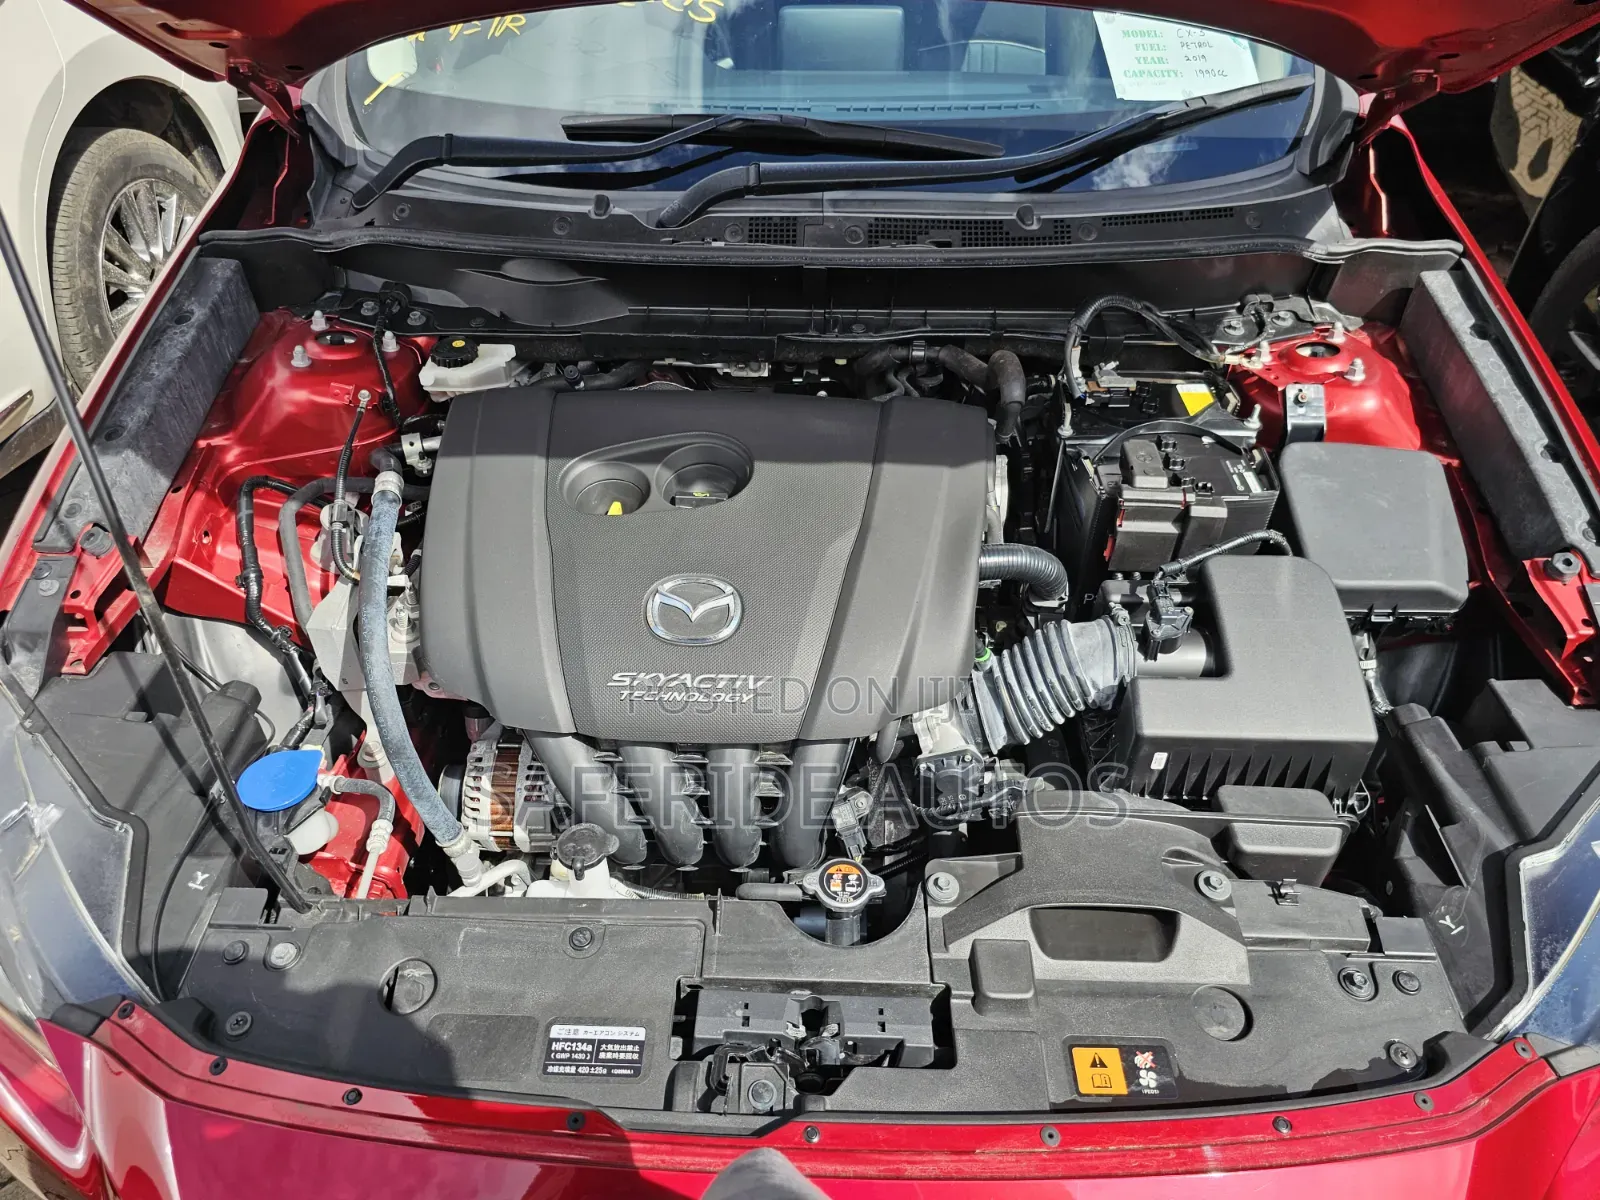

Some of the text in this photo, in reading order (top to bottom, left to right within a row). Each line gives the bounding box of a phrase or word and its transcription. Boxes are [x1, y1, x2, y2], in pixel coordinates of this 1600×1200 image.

[1121, 29, 1163, 39] MODEL:
[1135, 43, 1167, 52] FUEL:
[1180, 41, 1214, 50] PETROL
[1135, 56, 1169, 65] YEAR:
[1184, 54, 1207, 63] 2019
[1123, 69, 1184, 79] CAPACITY:
[607, 672, 774, 690] SKYACTIV
[619, 690, 756, 703] TECHNOLOGY
[551, 1041, 593, 1052] HFC134a
